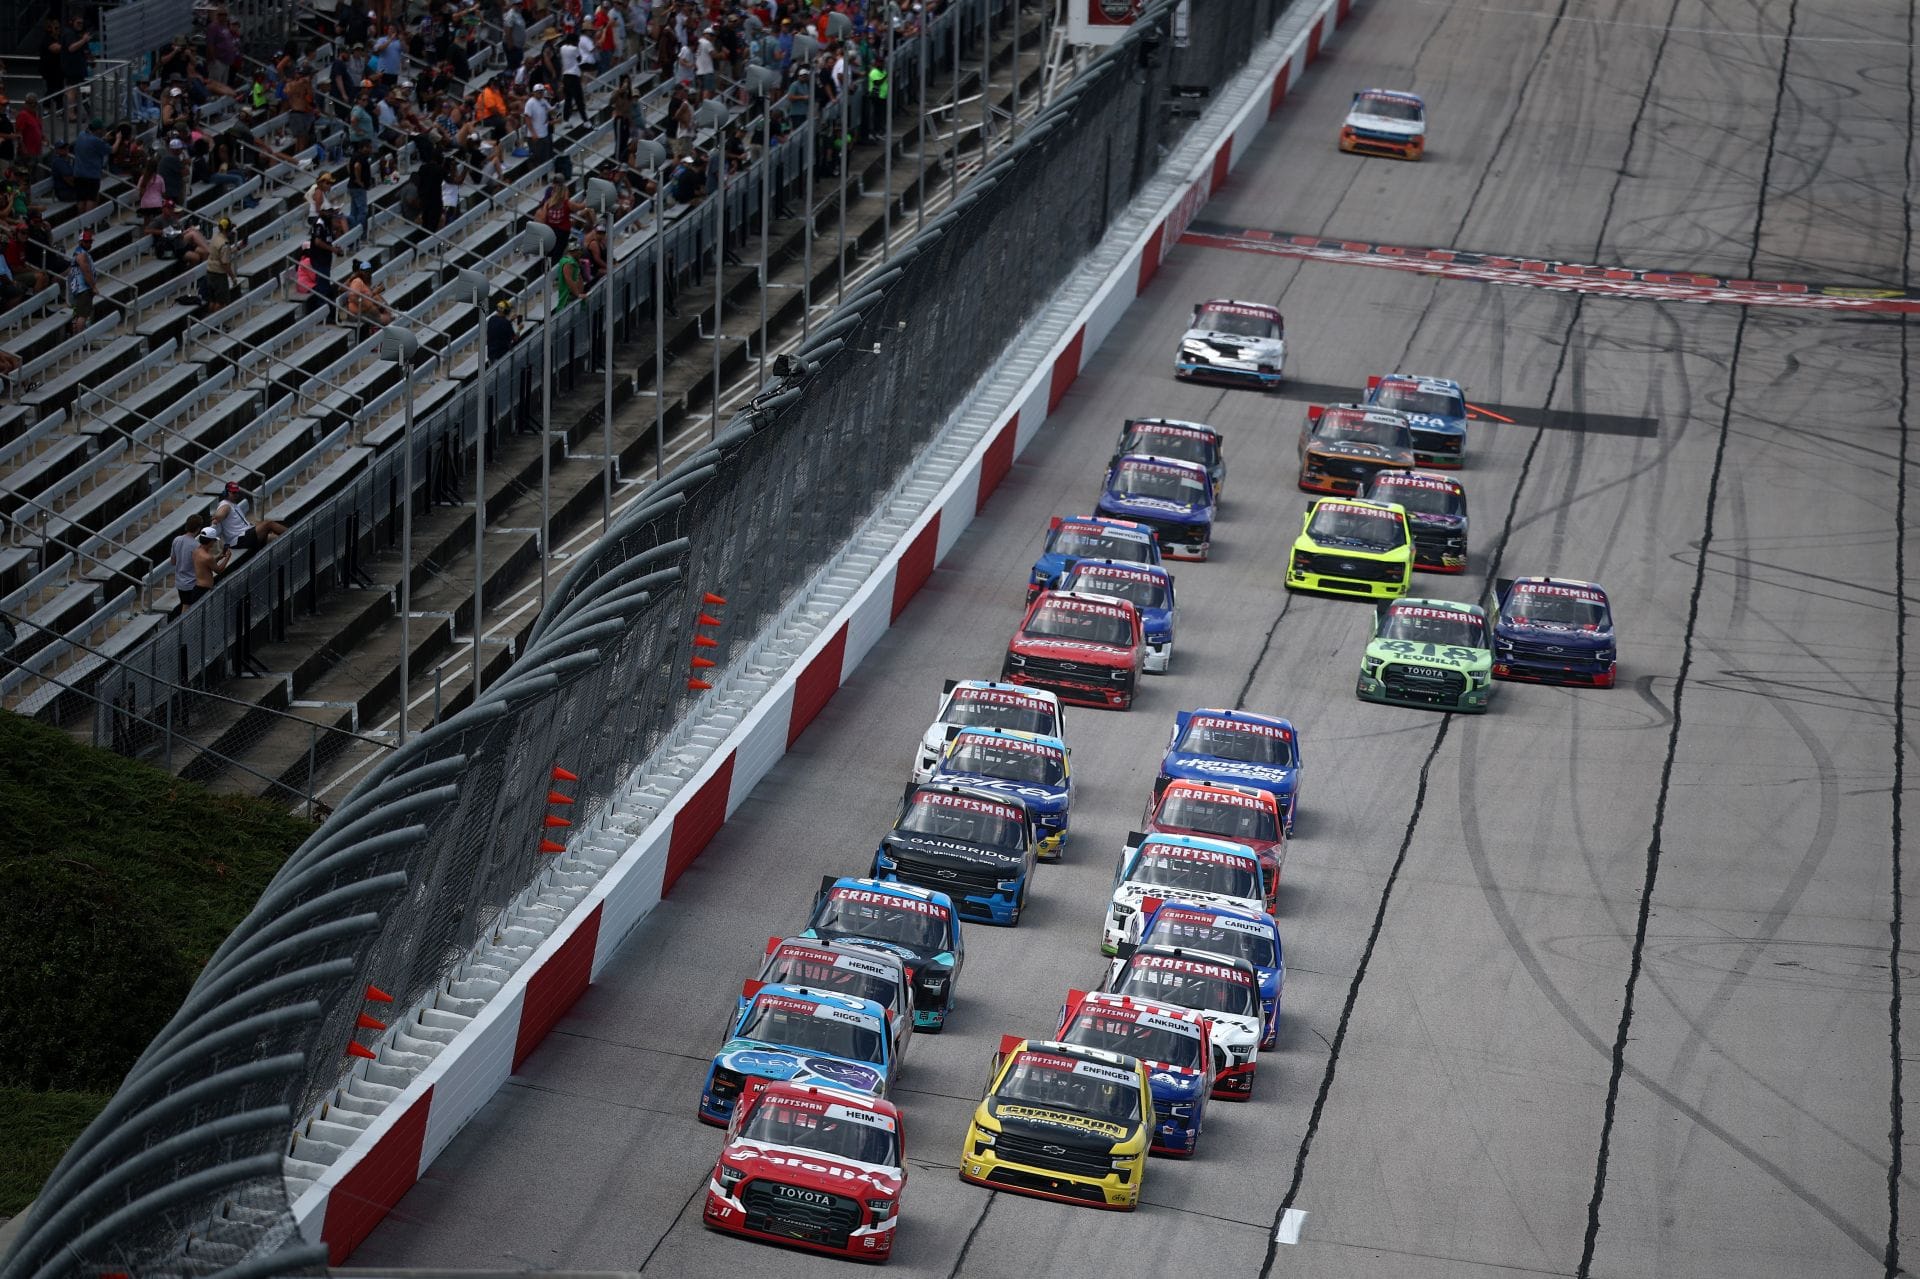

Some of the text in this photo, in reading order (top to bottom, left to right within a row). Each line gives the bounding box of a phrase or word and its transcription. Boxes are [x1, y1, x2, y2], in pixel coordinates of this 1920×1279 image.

[1208, 304, 1274, 319] CRAFTSMAN
[1138, 425, 1210, 441] CRAFTSMAN
[1123, 462, 1198, 480] CRAFTSMAN
[1381, 477, 1452, 492] CRAFTSMAN
[1321, 504, 1396, 520] CRAFTSMAN
[1081, 566, 1160, 584] CRAFTSMAN
[1521, 584, 1598, 600] CRAFTSMAN
[1046, 600, 1127, 619] CRAFTSMAN
[1396, 606, 1478, 624] CRAFTSMAN
[1393, 652, 1461, 667] TEQUILA
[1407, 667, 1444, 678] TOYOTA
[961, 689, 1047, 711] CRAFTSMAN
[1197, 717, 1284, 739] CRAFTSMAN
[966, 735, 1056, 758] CRAFTSMAN
[922, 795, 1016, 819] CRAFTSMAN
[1173, 788, 1264, 810] CRAFTSMAN
[910, 837, 1022, 864] GAINBRIDGE
[1150, 845, 1246, 868] CRAFTSMAN
[837, 889, 940, 917] CRAFTSMAN
[1164, 911, 1213, 924] CRAFTSMAN
[1225, 920, 1261, 933] CARUTH
[783, 949, 834, 962] CRAFTSMAN
[848, 961, 884, 975] HEMRIC
[1140, 956, 1245, 982] CRAFTSMAN
[762, 998, 814, 1012] CRAFTSMAN
[1085, 1006, 1136, 1019] CRAFTSMAN
[833, 1010, 861, 1023] RIGGS
[1147, 1017, 1189, 1033] ANKRUM
[1020, 1054, 1073, 1068] CRAFTSMAN
[1082, 1065, 1130, 1082] ENFINGER
[765, 1096, 823, 1111] CRAFTSMAN
[846, 1110, 875, 1123] HEIM
[1005, 1106, 1121, 1135] CHAMPION
[779, 1186, 830, 1206] TOYOTA
[720, 1207, 731, 1217] 11
